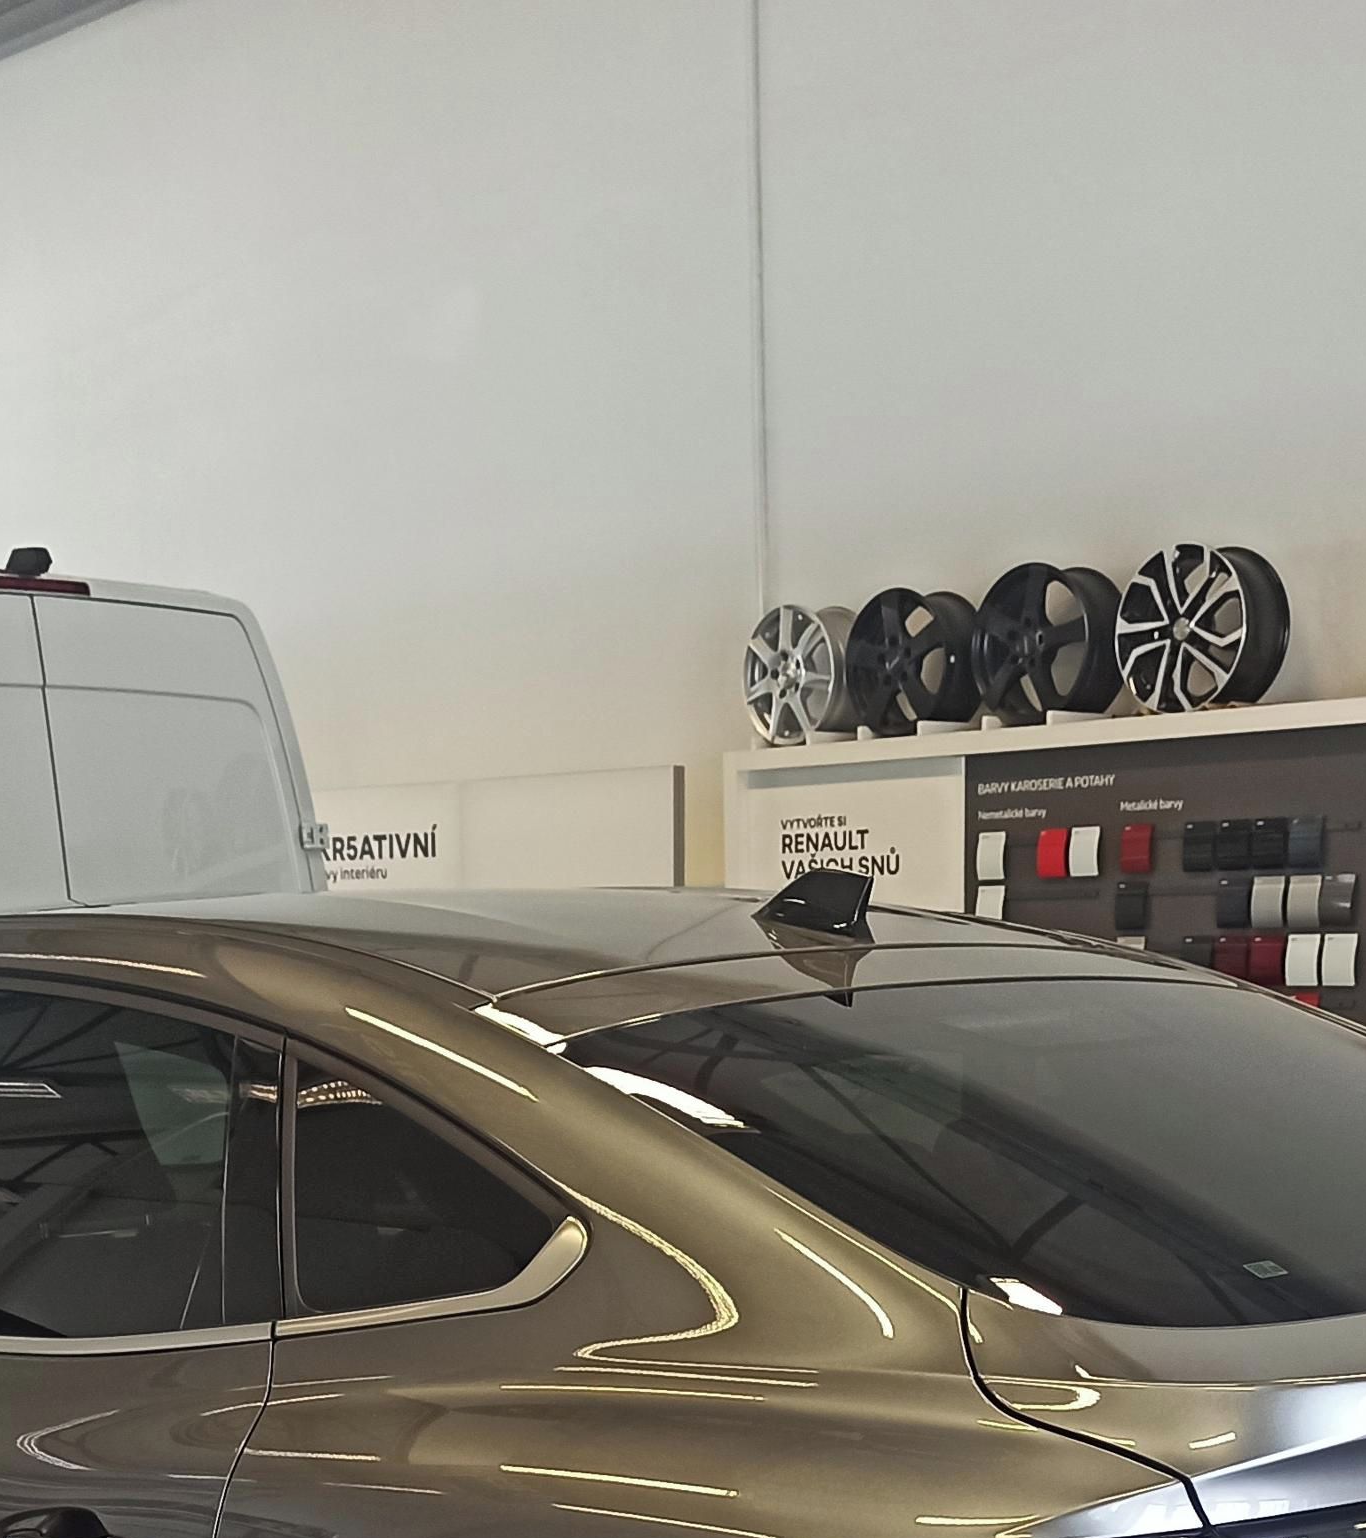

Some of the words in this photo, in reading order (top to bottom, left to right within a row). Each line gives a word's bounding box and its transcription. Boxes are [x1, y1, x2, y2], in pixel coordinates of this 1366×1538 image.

[977, 782, 1010, 796] BARVY
[1065, 778, 1074, 789] A
[1074, 774, 1115, 789] POTAHY
[1159, 798, 1184, 810] barvy
[781, 814, 835, 830] VYTVOŘTE
[837, 815, 847, 826] SI
[781, 829, 869, 854] RENAULT
[858, 846, 900, 876] SNŮ
[340, 865, 388, 880] interiéru
